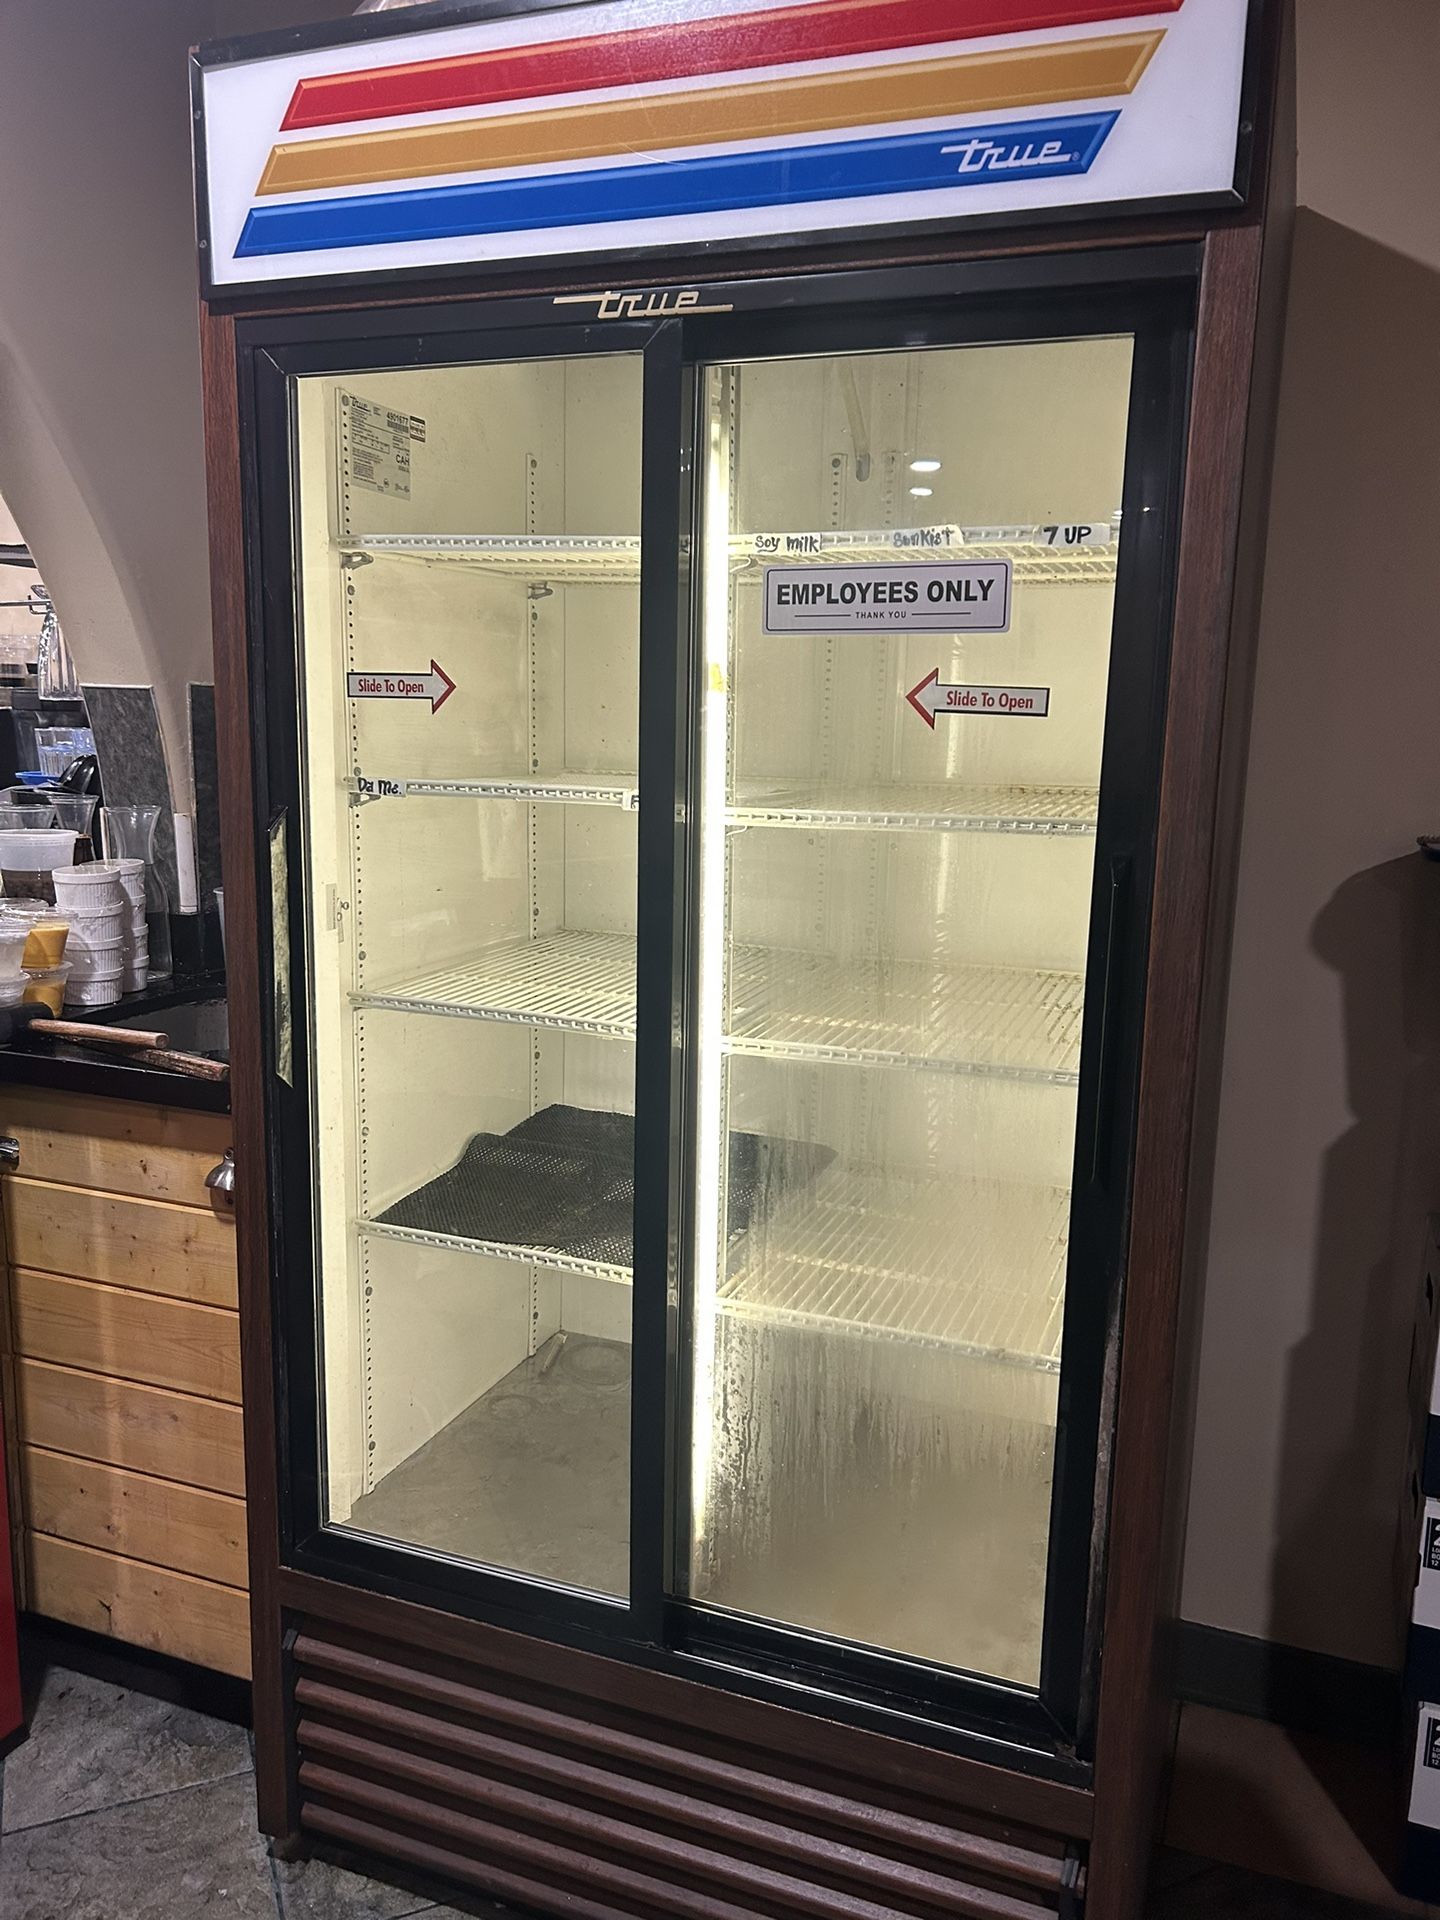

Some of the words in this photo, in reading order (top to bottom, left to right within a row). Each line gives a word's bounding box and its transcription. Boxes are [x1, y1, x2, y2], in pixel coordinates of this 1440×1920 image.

[940, 139, 1071, 173] true
[552, 291, 734, 319] true
[1043, 526, 1059, 545] 7
[1064, 526, 1092, 544] UP
[777, 580, 919, 605] EMPLOYEES
[926, 579, 995, 603] ONLY
[855, 611, 885, 619] THANK
[889, 610, 907, 619] YOU
[358, 678, 382, 692] Slide
[384, 679, 395, 693] To
[398, 679, 424, 695] Open
[946, 690, 978, 706] Slide
[981, 692, 995, 707] To
[999, 692, 1034, 711] Open
